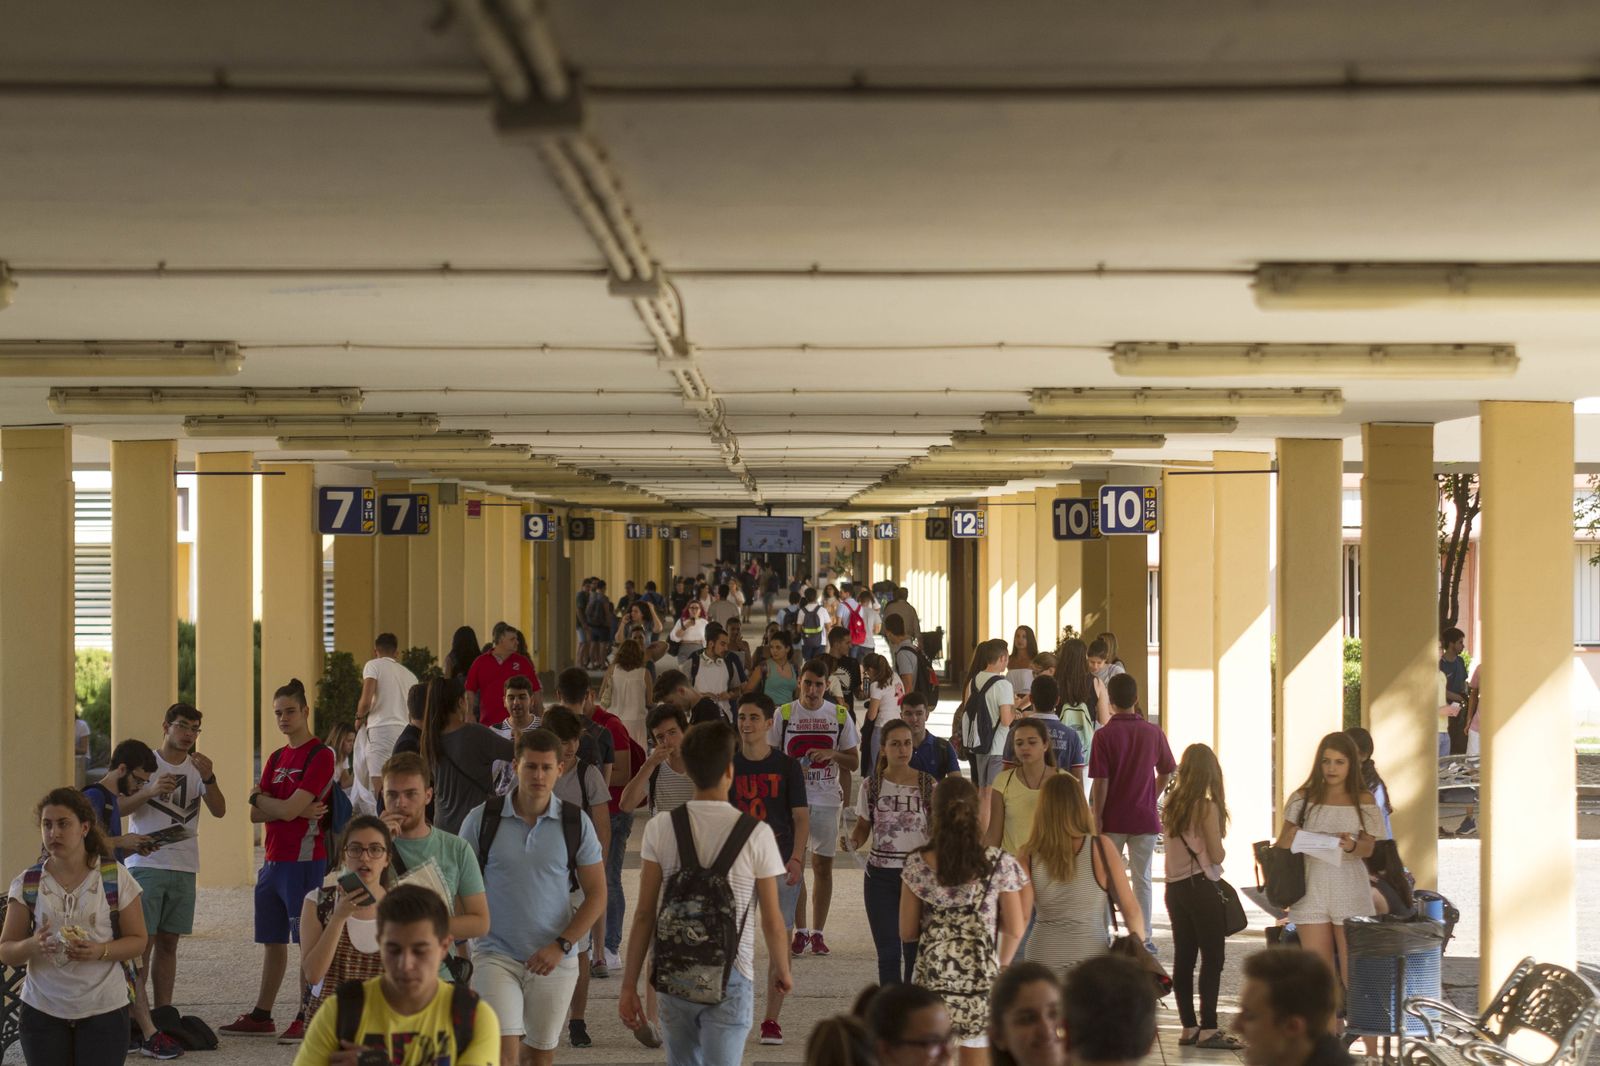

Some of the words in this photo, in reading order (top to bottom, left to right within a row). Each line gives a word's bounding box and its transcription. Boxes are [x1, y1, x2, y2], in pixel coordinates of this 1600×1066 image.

[326, 491, 354, 529] 7
[366, 501, 373, 509] 9
[1102, 490, 1141, 529] 10
[1145, 500, 1156, 508] 12
[364, 511, 374, 519] 11
[387, 498, 411, 531] 7
[954, 512, 976, 535] 12
[1055, 503, 1089, 535] 10
[528, 516, 544, 538] 9
[571, 519, 585, 538] 9
[628, 524, 640, 538] 11
[659, 527, 670, 538] 13
[857, 526, 868, 537] 16
[880, 524, 893, 538] 14
[927, 520, 945, 538] 12
[735, 773, 782, 800] JUST
